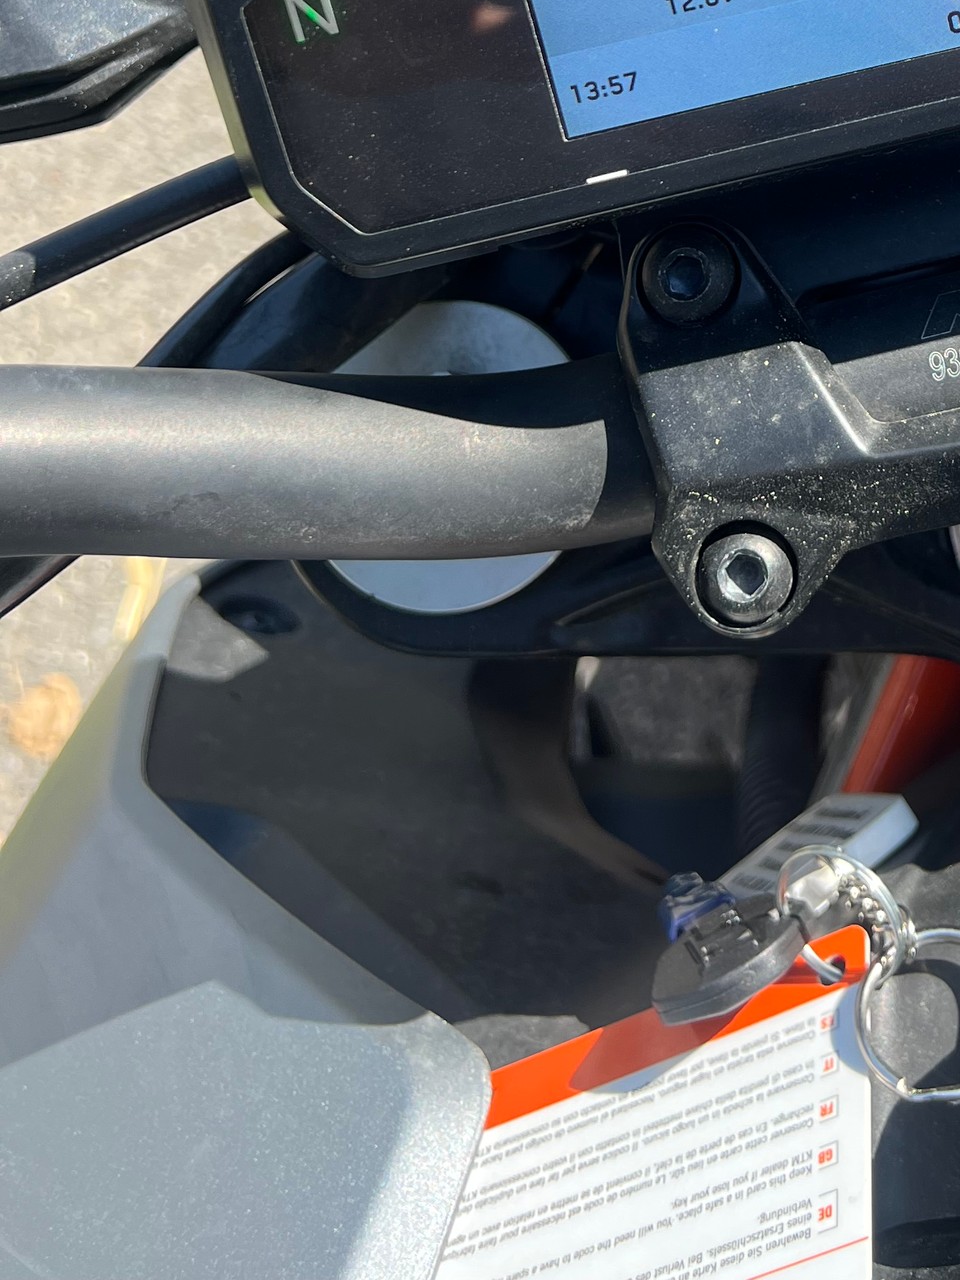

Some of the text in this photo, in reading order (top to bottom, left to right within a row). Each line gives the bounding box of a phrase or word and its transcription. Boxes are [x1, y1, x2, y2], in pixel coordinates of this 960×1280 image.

[570, 72, 639, 104] 13:57
[823, 1059, 833, 1071] IT
[819, 1103, 833, 1117] FR
[737, 1126, 753, 1139] cas
[755, 1121, 767, 1132] En
[770, 1117, 813, 1140] Conserver
[723, 1133, 735, 1144] de
[744, 1135, 767, 1150] cette
[674, 1154, 683, 1163] la
[685, 1148, 696, 1159] de
[720, 1144, 742, 1159] carte
[817, 1148, 833, 1164] GB
[687, 1159, 704, 1172] lieu
[706, 1154, 718, 1165] en
[788, 1163, 812, 1179] Keep
[654, 1173, 666, 1184] Le
[671, 1149, 812, 1209] KTM dealer if you lose your key.
[768, 1173, 786, 1187] this
[592, 1184, 603, 1195] de
[734, 1189, 743, 1200] in
[746, 1181, 766, 1198] card
[583, 1197, 604, 1211] code
[606, 1191, 617, 1203] de
[704, 1196, 723, 1212] safe
[726, 1193, 732, 1203] a
[567, 1205, 581, 1219] est
[675, 1203, 702, 1221] place.
[757, 1198, 812, 1223] Verbindung.
[818, 1205, 832, 1221] DE
[656, 1216, 672, 1229] You
[786, 1212, 812, 1228] eines
[638, 1223, 653, 1238] will
[596, 1238, 611, 1251] the
[613, 1230, 635, 1247] need
[706, 1222, 783, 1257] Ersatzschlüssels.
[765, 1227, 811, 1251] Bewahren
[561, 1253, 571, 1263] to
[573, 1245, 594, 1260] code
[687, 1251, 702, 1266] Bei
[747, 1245, 762, 1258] Sie
[539, 1257, 559, 1271] have
[719, 1251, 744, 1267] diese
[531, 1265, 537, 1274] a
[653, 1259, 684, 1278] Verlust
[692, 1261, 717, 1280] Karte
